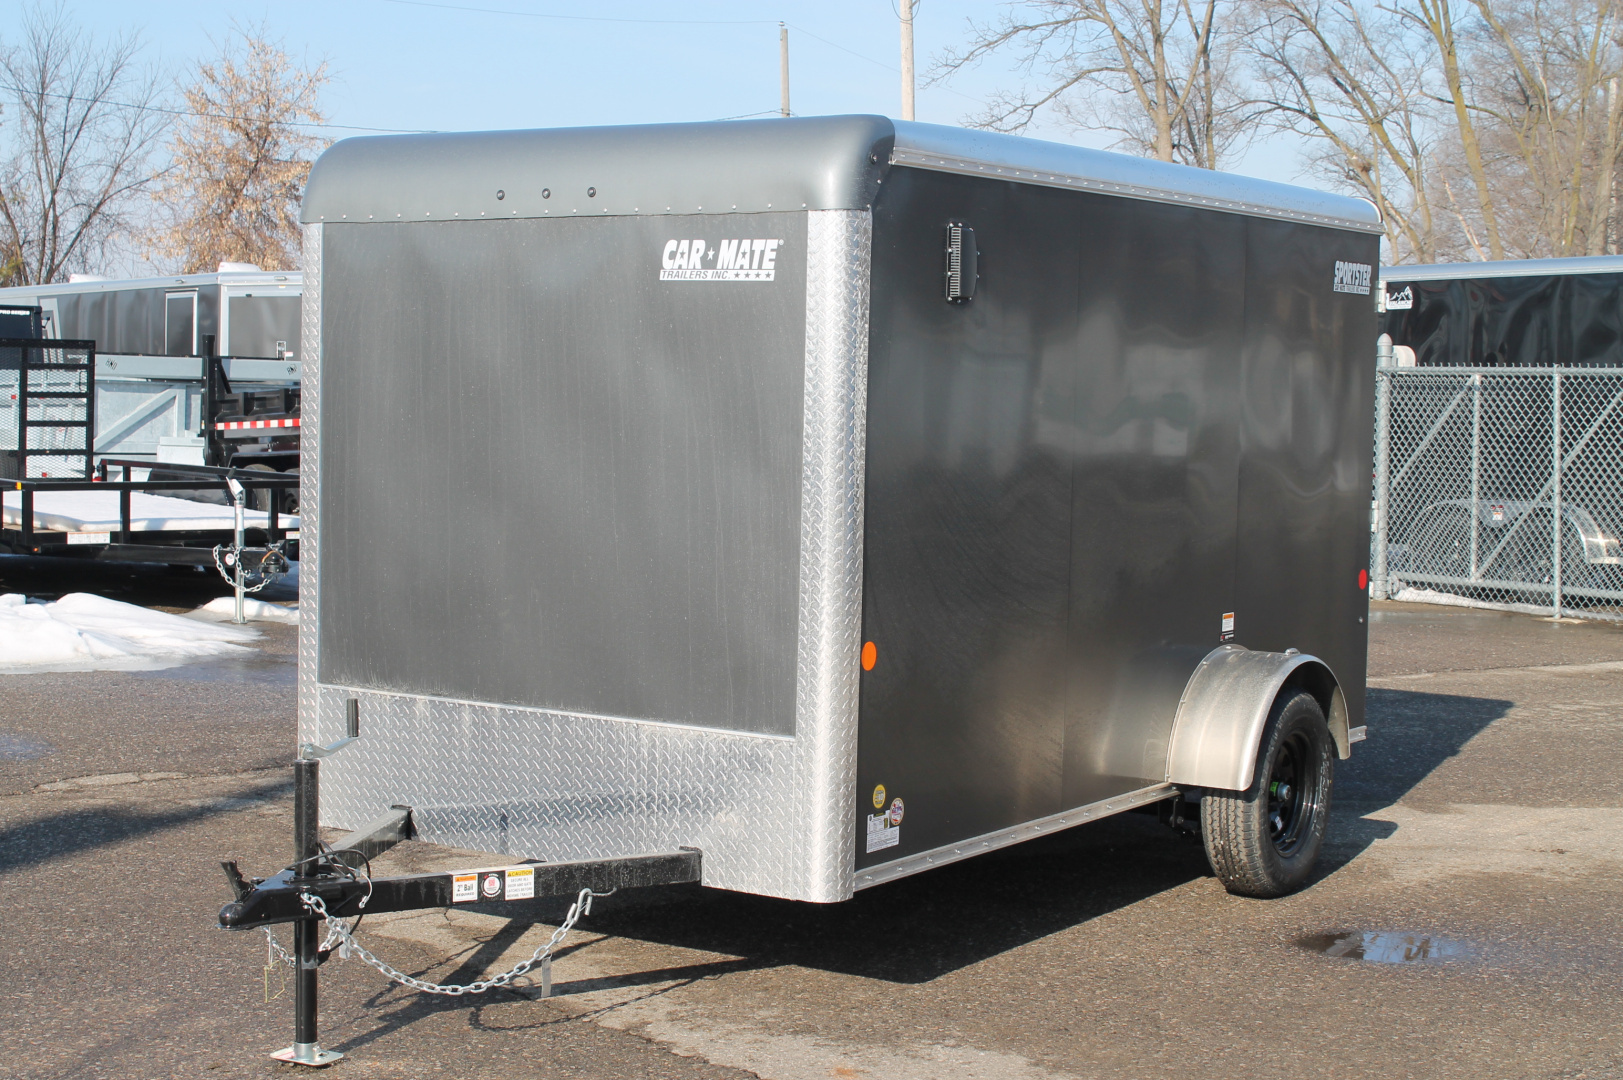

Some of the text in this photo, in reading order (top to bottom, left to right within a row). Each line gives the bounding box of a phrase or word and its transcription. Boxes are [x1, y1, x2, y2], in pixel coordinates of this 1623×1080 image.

[662, 239, 779, 270] CAR MATE
[662, 270, 731, 280] TRAILERS INC.
[1334, 260, 1372, 286] SPORTSTER
